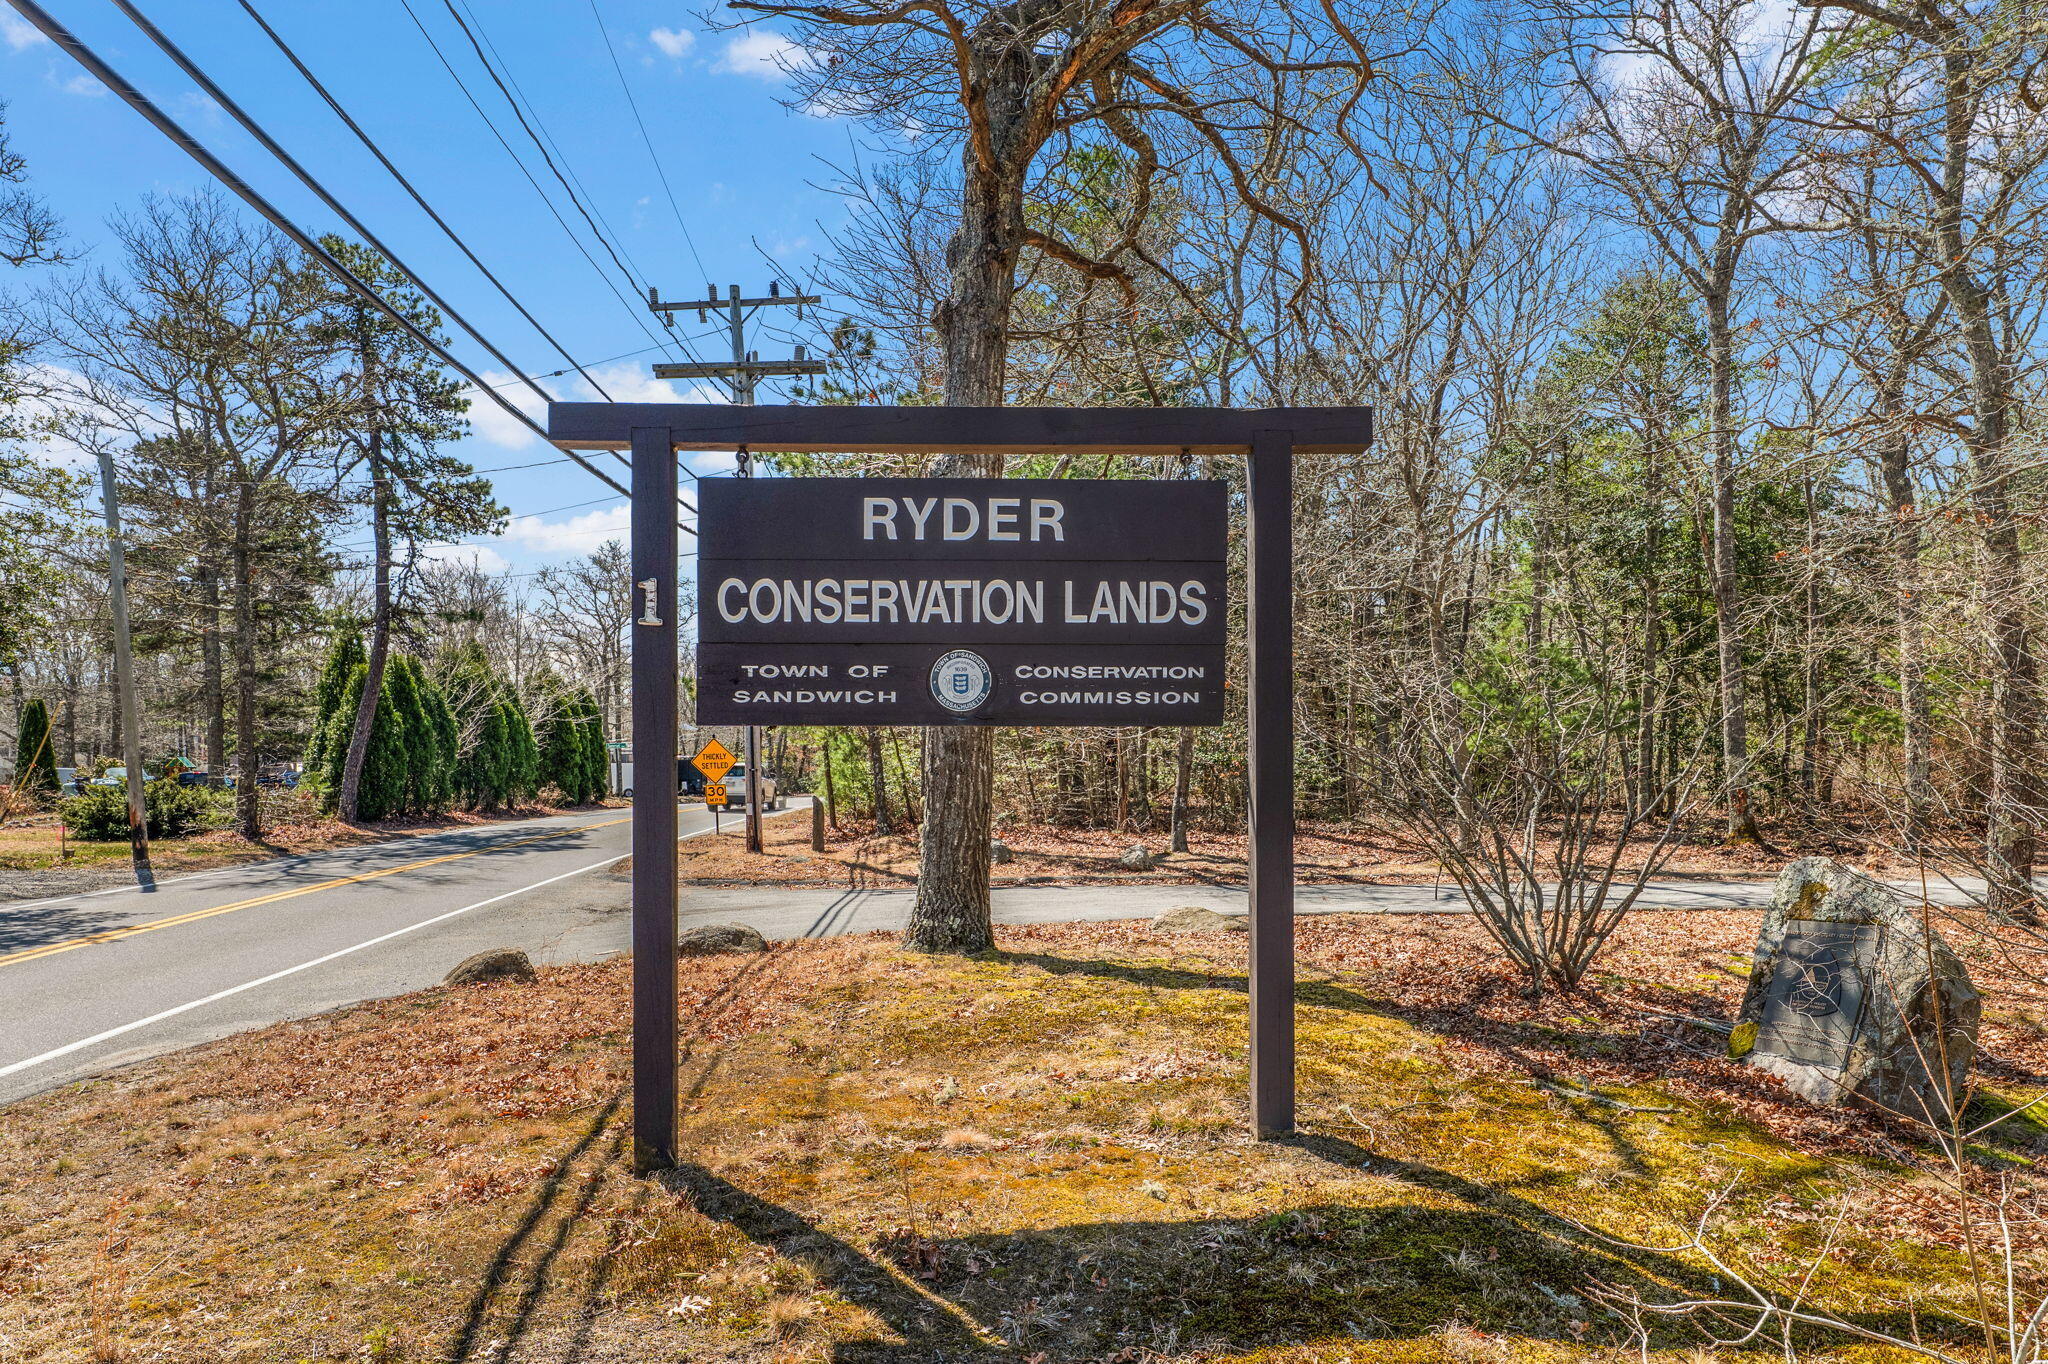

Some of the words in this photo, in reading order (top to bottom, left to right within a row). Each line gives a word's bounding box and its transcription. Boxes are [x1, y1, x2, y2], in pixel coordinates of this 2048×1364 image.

[862, 497, 1065, 542] RYDER
[637, 577, 663, 626] 1
[717, 577, 1044, 625] CONSERVATION
[1064, 579, 1208, 626] LANDS
[935, 656, 949, 673] TOWN
[961, 652, 988, 673] SANDWICH
[741, 664, 828, 678] TOWN
[848, 664, 889, 678] OF
[1015, 665, 1205, 679] CONSERVATION
[732, 690, 897, 704] SANDWICH
[938, 692, 986, 710] MASSACHUSETTS
[1019, 691, 1200, 705] COMMISSION
[708, 787, 724, 796] 30
